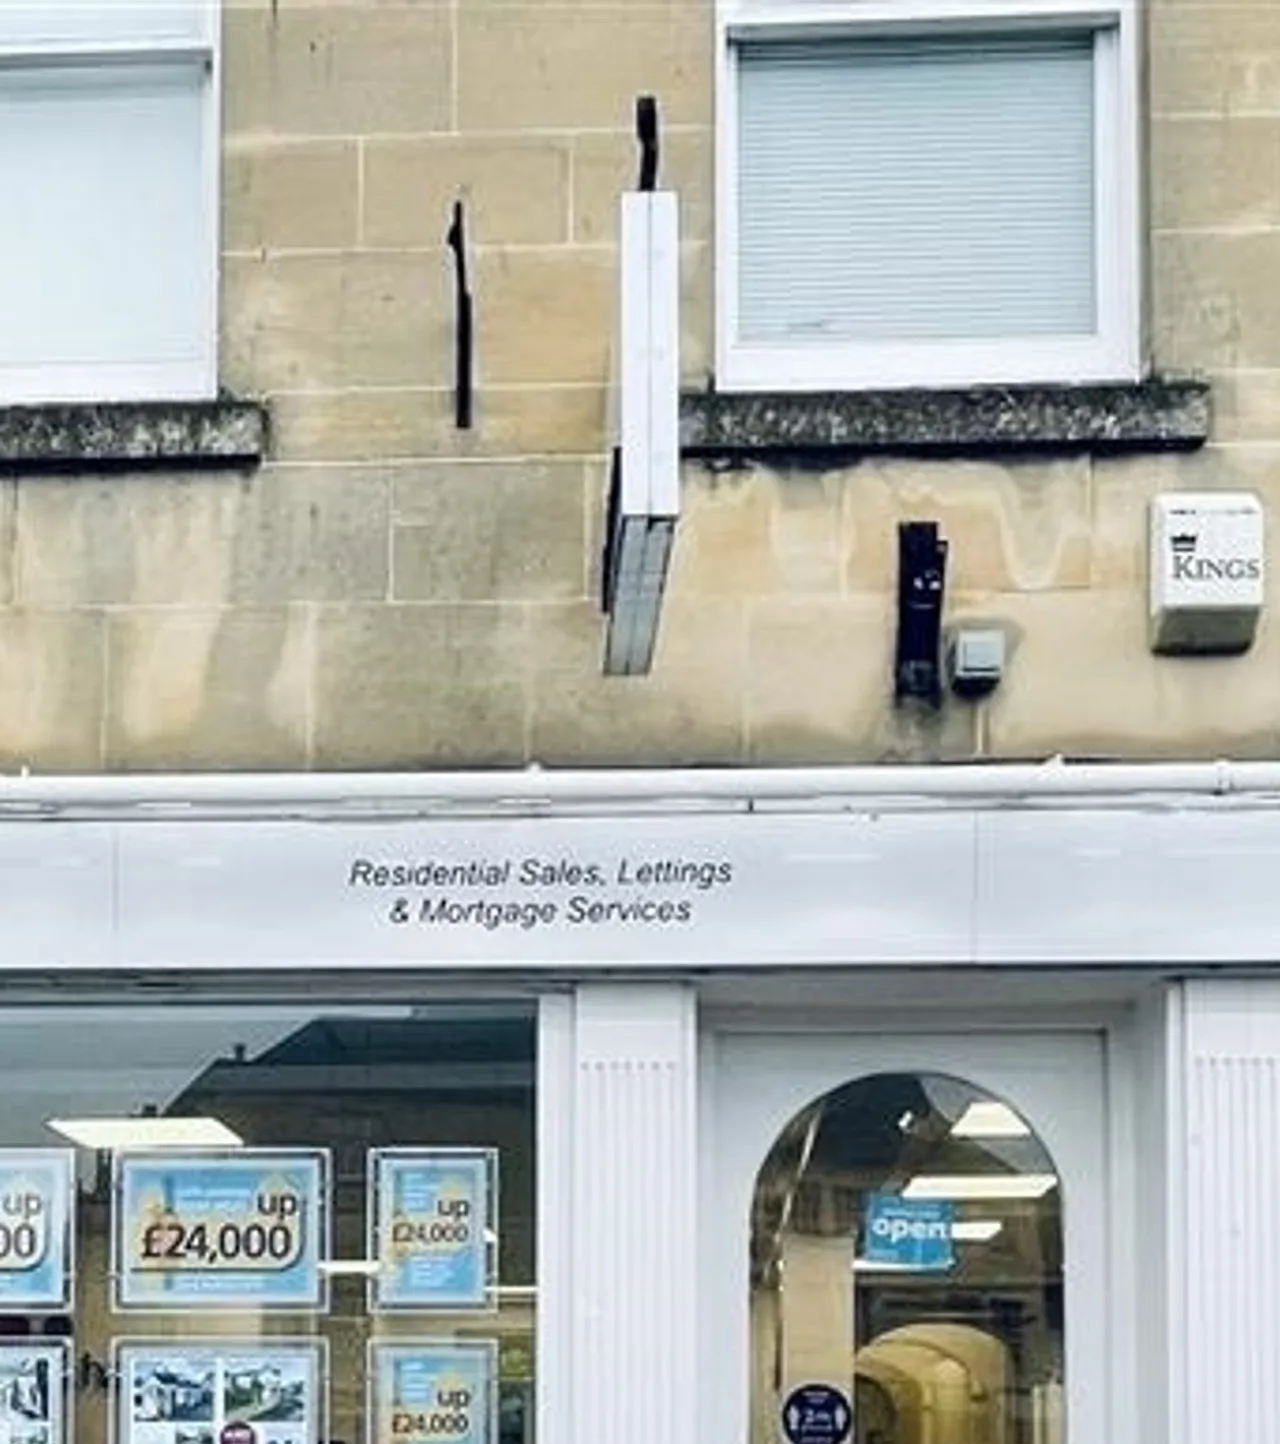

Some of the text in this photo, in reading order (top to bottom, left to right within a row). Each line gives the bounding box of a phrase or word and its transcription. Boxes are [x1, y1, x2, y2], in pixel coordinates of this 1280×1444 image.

[1172, 555, 1260, 580] KINGS
[349, 858, 733, 889] Residential Sales, Lettings
[389, 897, 692, 930] & Mortgage Services
[3, 1194, 42, 1218] up
[257, 1193, 298, 1219] up
[437, 1199, 469, 1219] up
[872, 1218, 947, 1244] open
[142, 1224, 293, 1264] £24,000
[437, 1391, 469, 1412] up
[392, 1414, 469, 1434] £24,000
